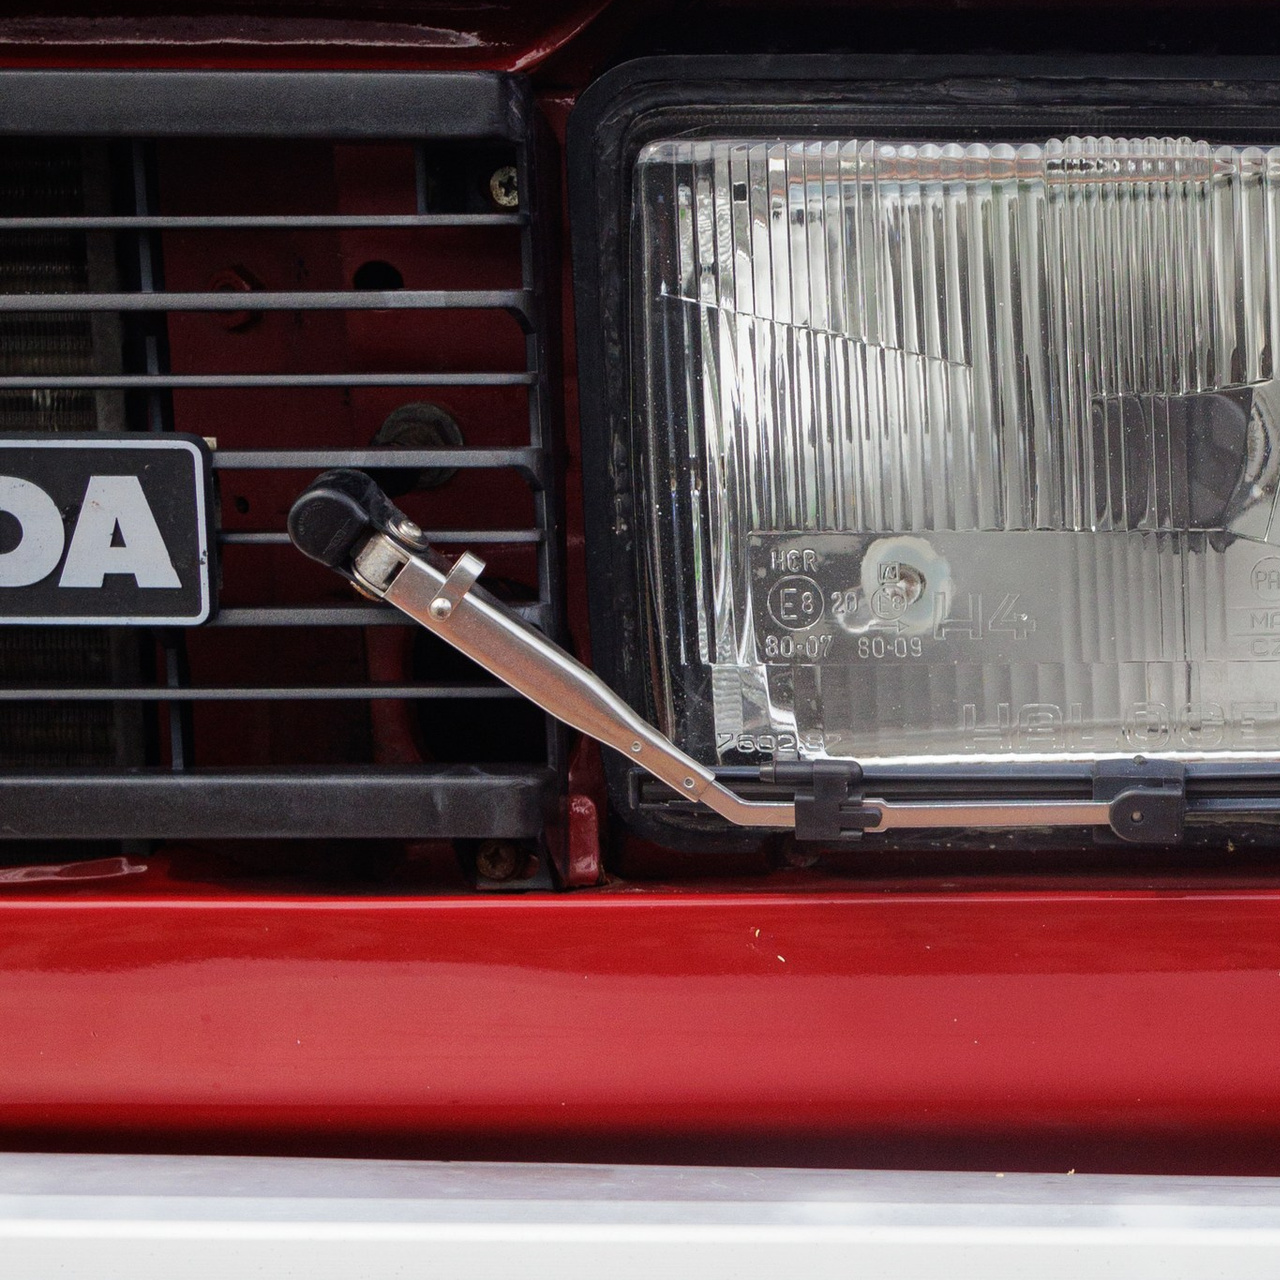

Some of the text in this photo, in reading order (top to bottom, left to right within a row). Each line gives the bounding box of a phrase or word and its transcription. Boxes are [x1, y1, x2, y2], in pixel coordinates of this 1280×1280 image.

[771, 549, 817, 573] HCR
[779, 588, 858, 620] E8 20
[932, 591, 1037, 641] H4
[764, 634, 834, 658] 80-07
[857, 636, 923, 659] 80-09
